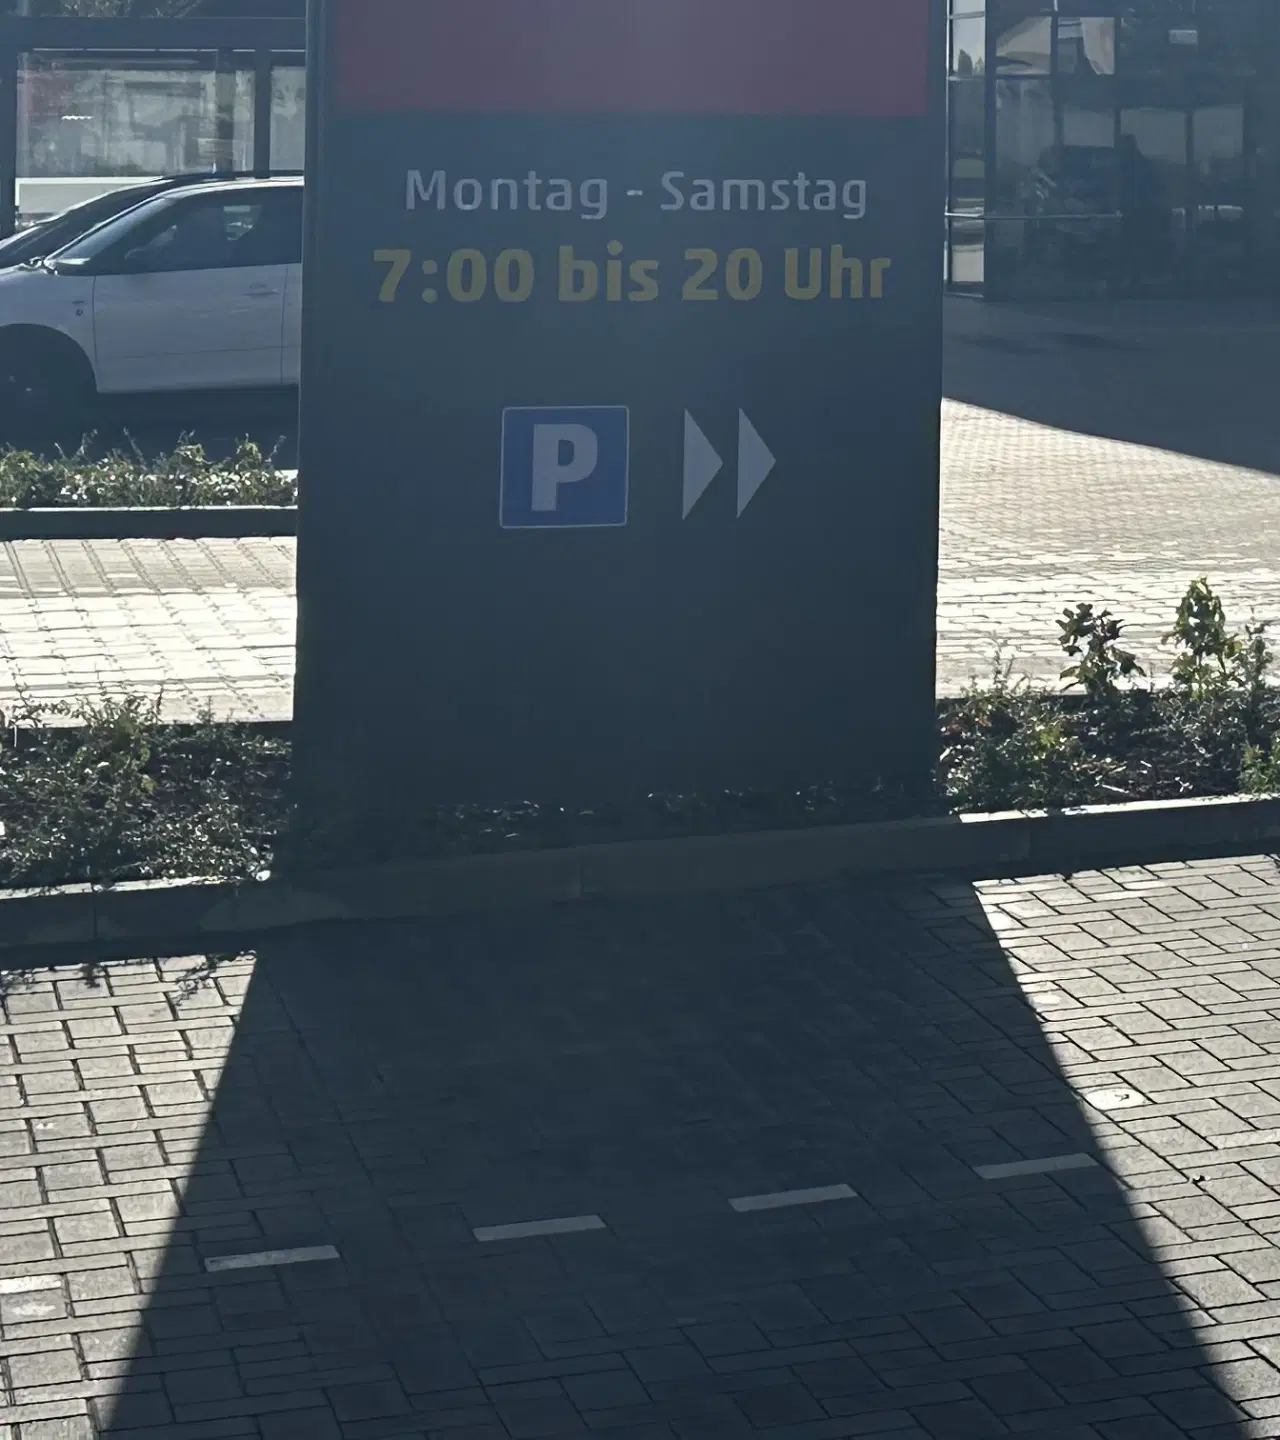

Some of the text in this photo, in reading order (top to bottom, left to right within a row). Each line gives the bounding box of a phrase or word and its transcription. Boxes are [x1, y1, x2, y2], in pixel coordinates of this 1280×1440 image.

[405, 168, 608, 220] Montag
[660, 170, 867, 220] Samstag
[372, 240, 891, 303] 7:00 bis 20 Uhr
[531, 423, 598, 511] P
